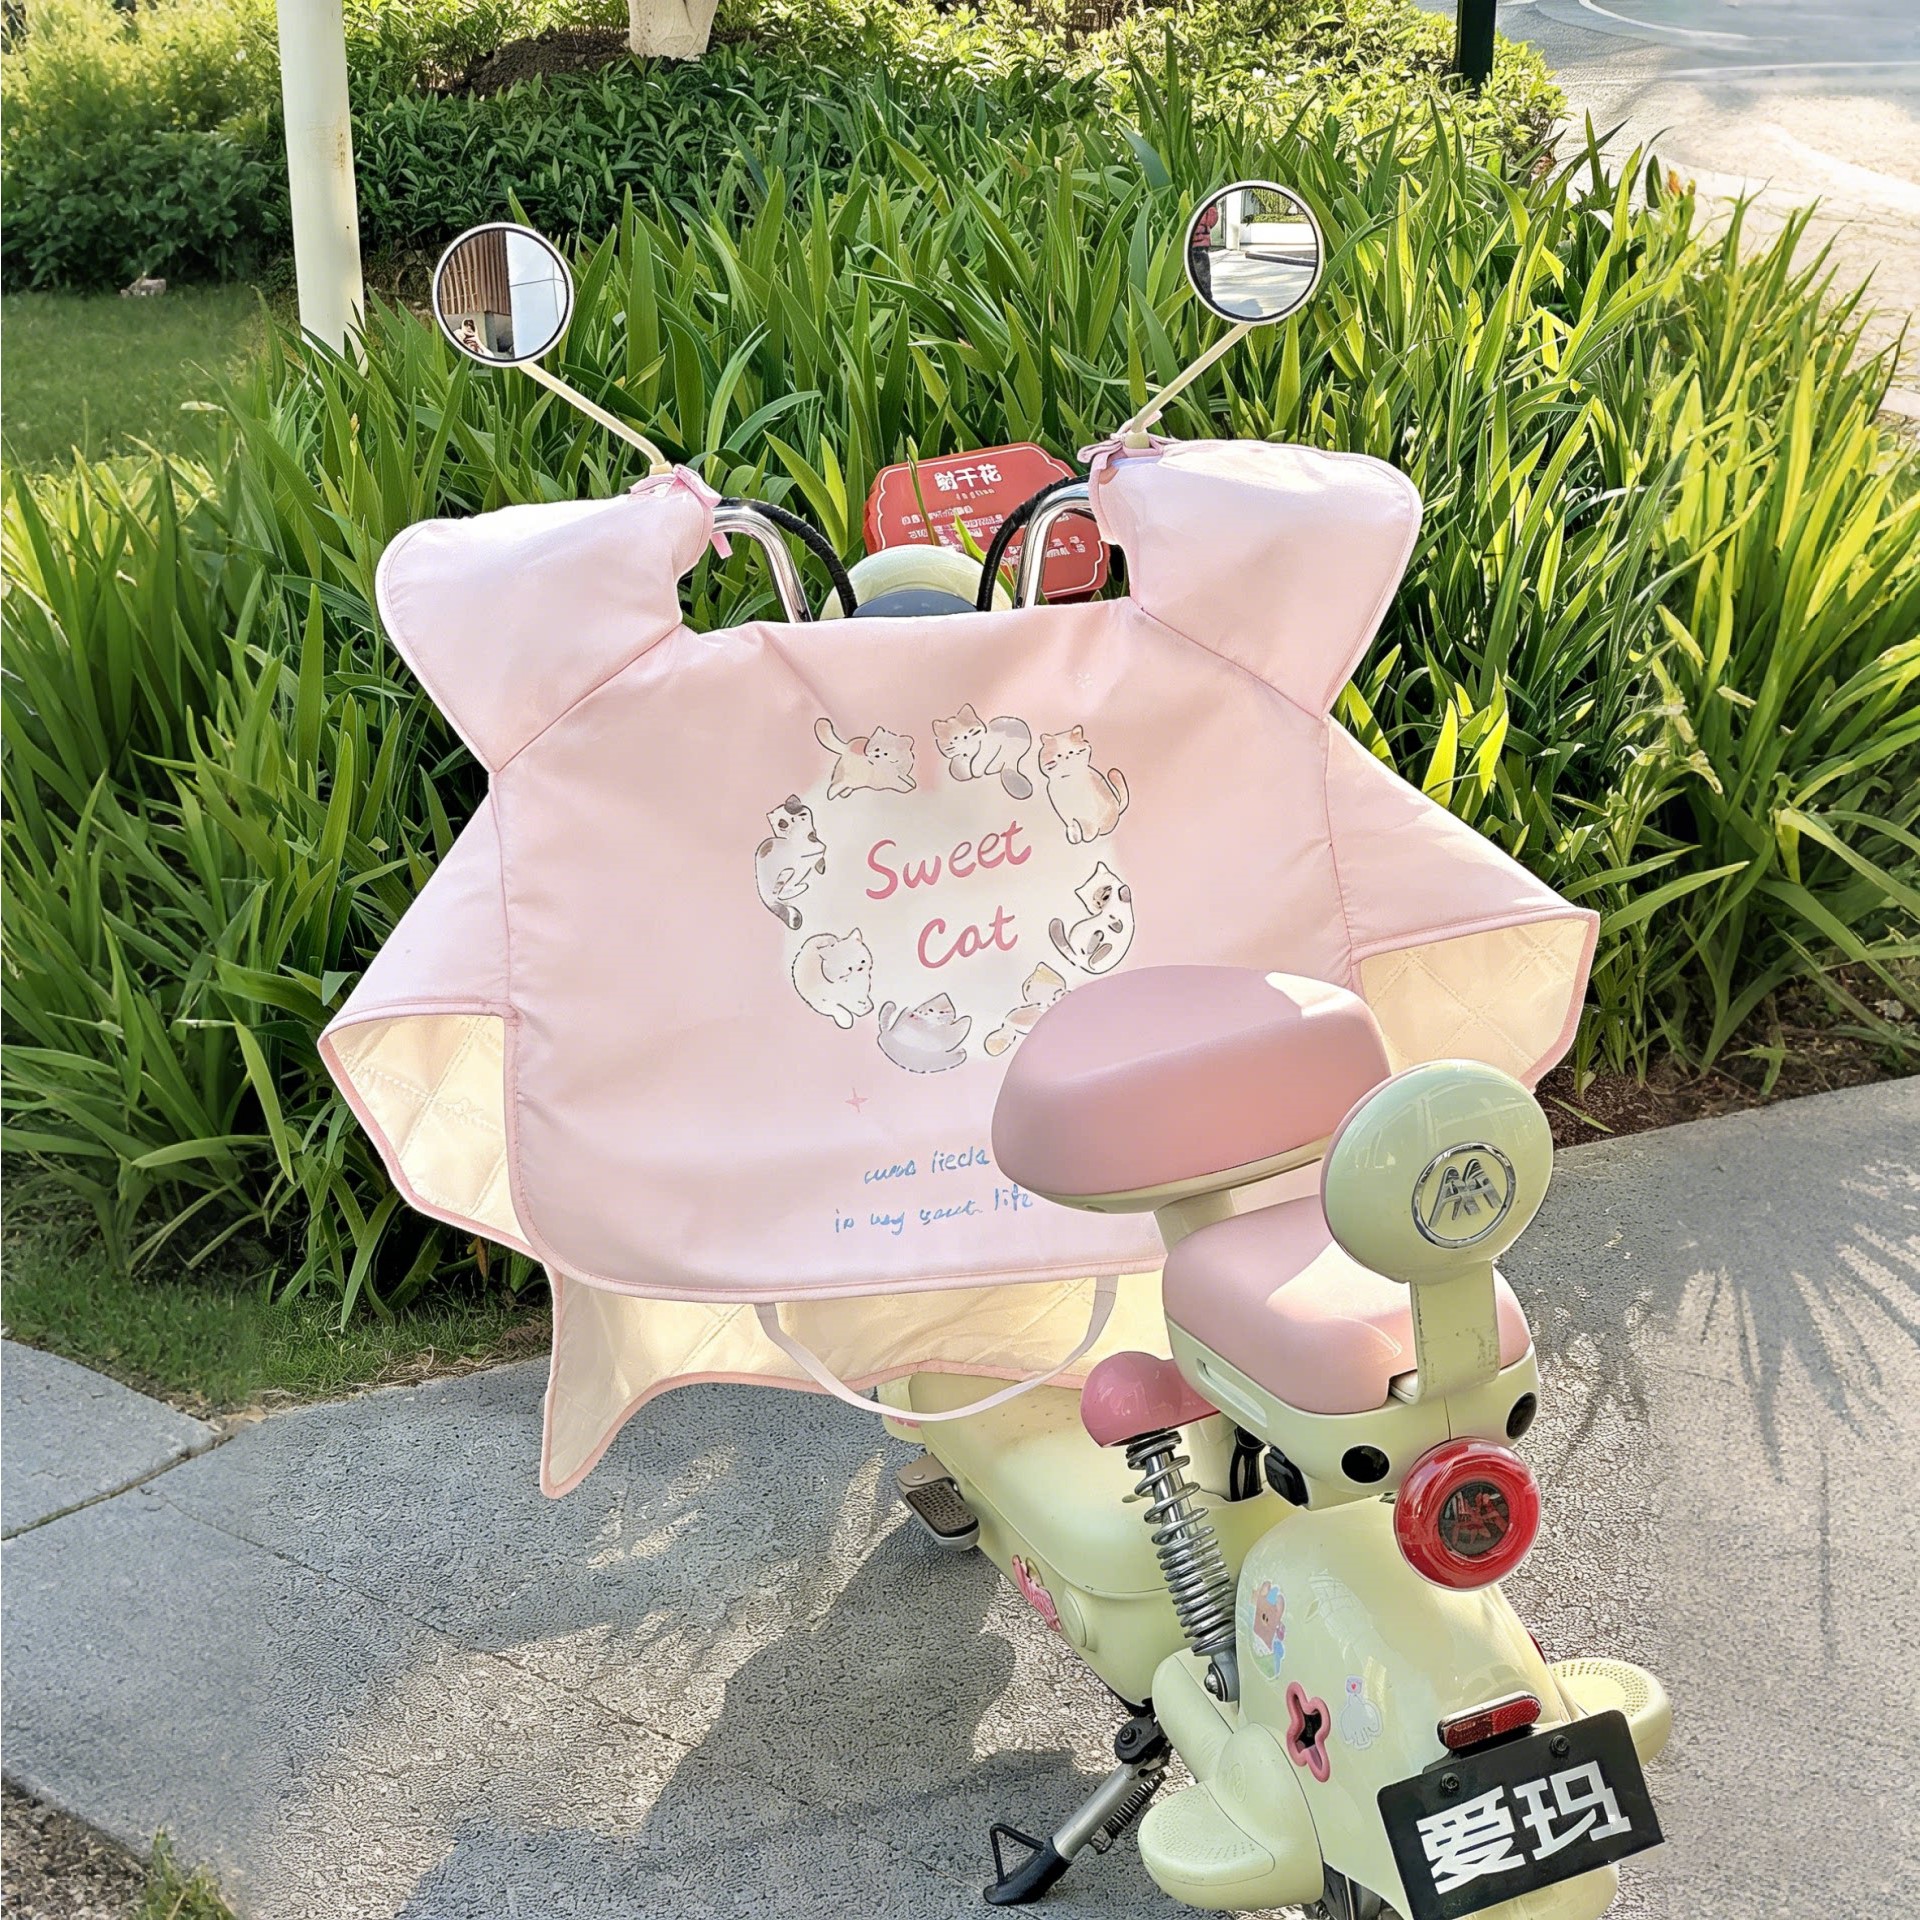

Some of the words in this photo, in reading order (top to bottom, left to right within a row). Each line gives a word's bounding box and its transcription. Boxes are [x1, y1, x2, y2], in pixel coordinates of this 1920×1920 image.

[865, 820, 1032, 900] Sweet
[917, 905, 1019, 968] Cat
[1415, 1760, 1633, 1895] 爱玛
